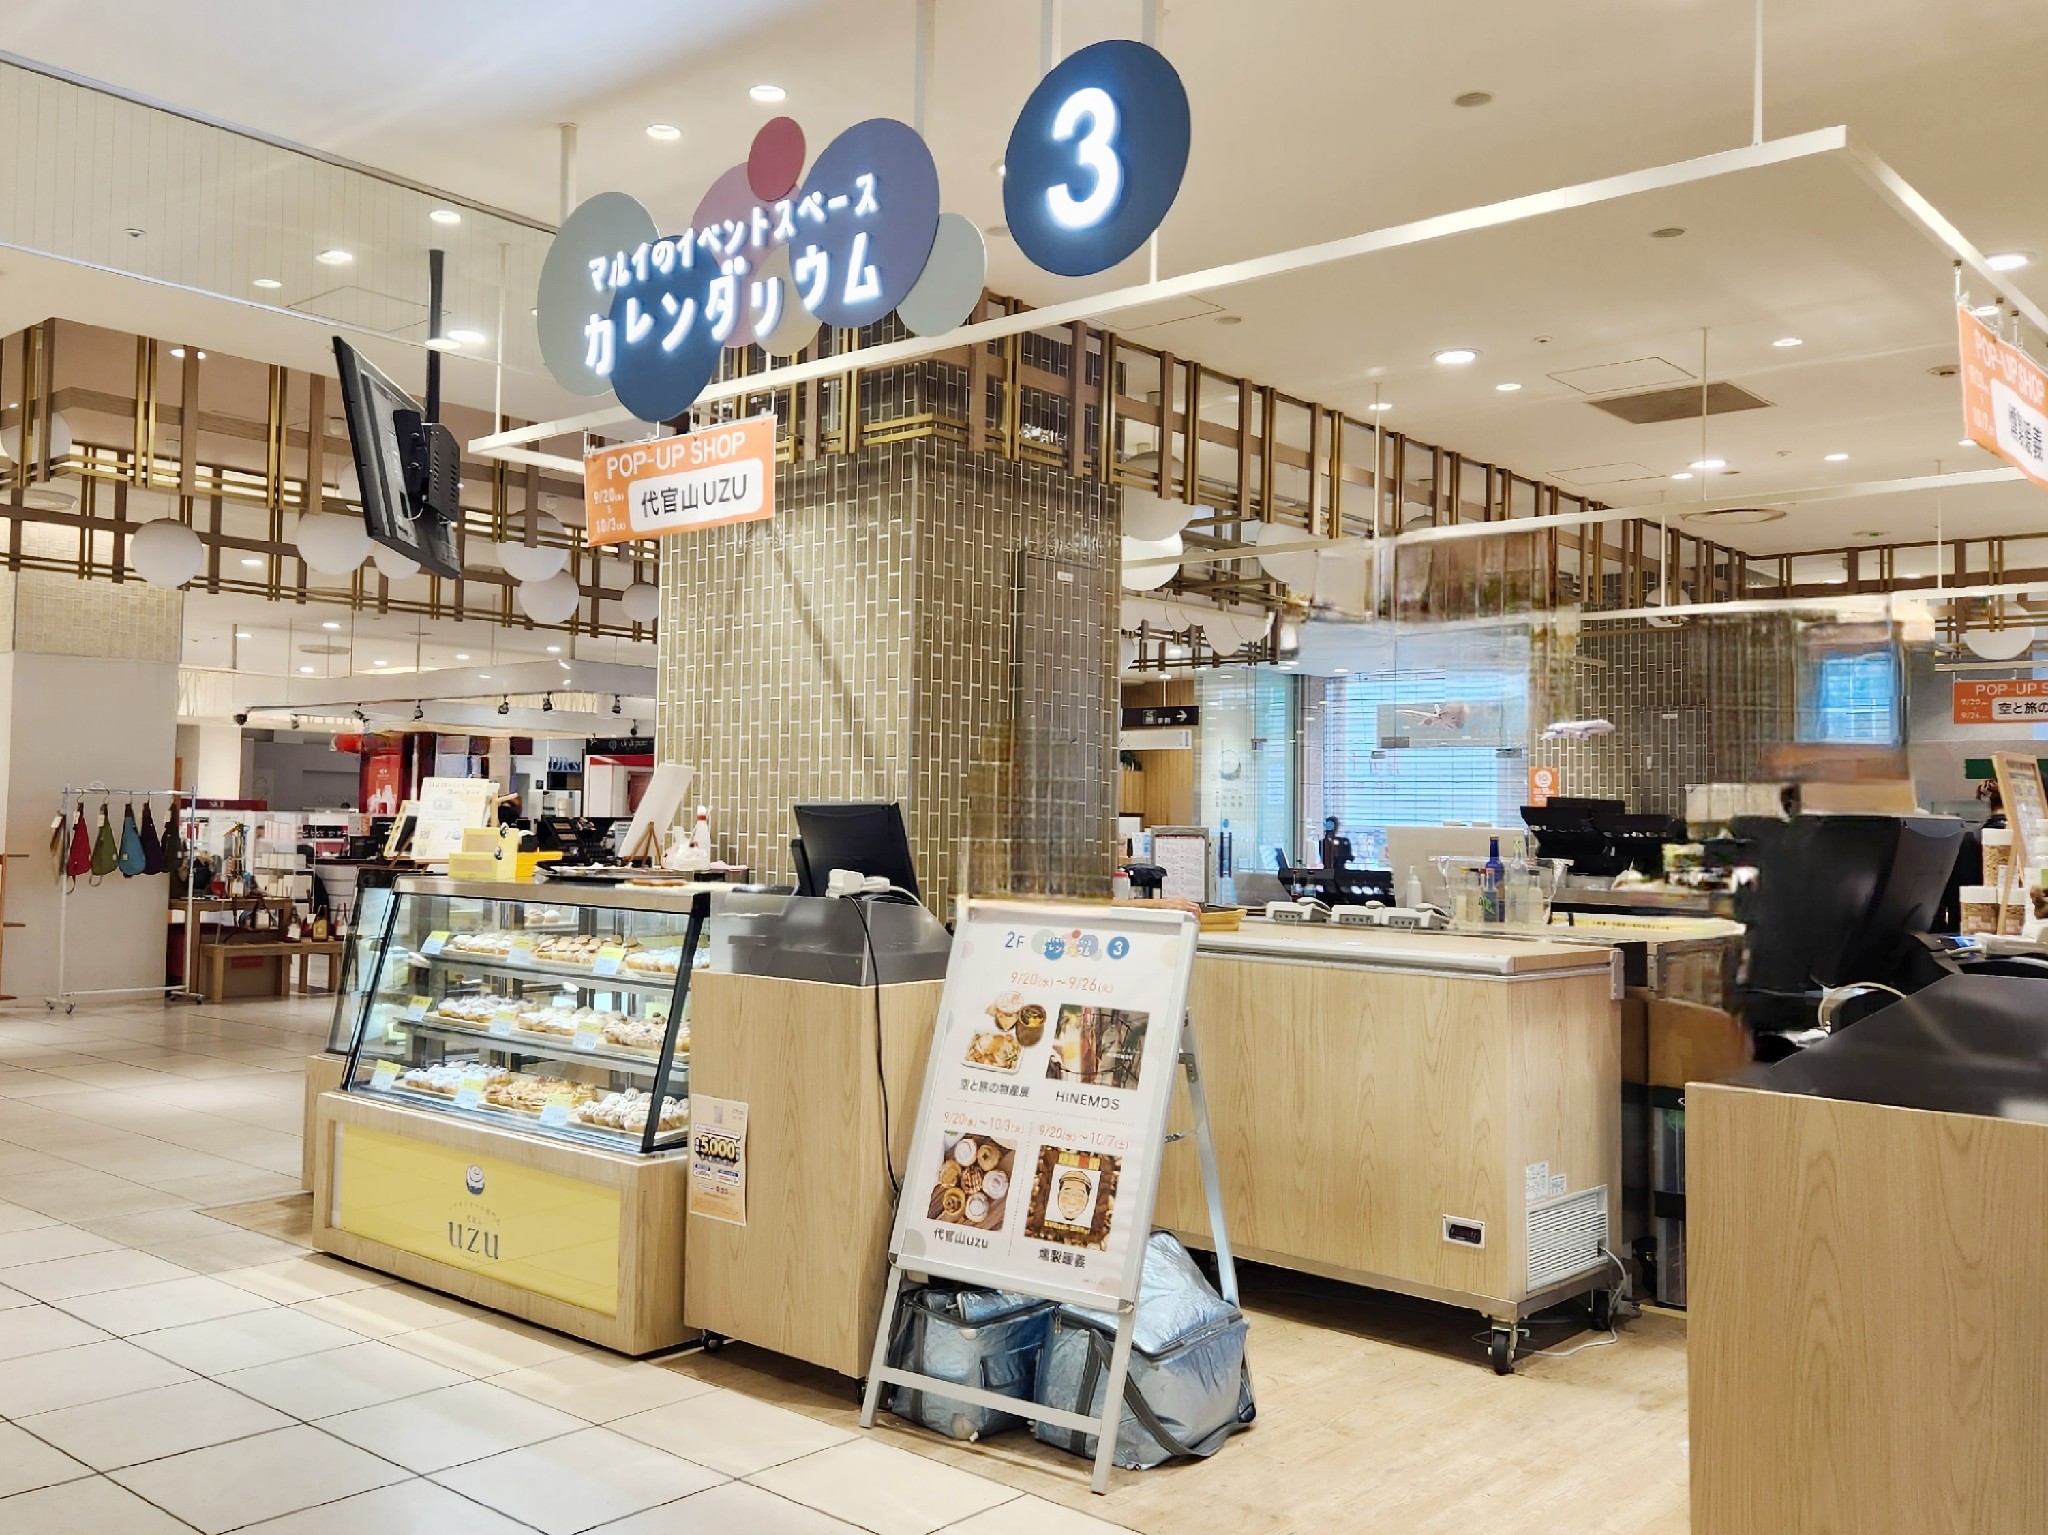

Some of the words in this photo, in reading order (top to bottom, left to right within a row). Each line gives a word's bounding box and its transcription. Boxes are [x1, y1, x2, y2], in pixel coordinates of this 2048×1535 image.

[1045, 86, 1122, 228] 3
[588, 173, 880, 293] マルイのイベントスペース
[584, 231, 884, 376] カレンダリウム
[606, 444, 685, 480] POP-UP
[690, 431, 746, 465] SHOP
[641, 473, 748, 518] 代官山UZU
[1976, 683, 2037, 695] POP-UP
[1005, 931, 1025, 949] 2F
[1112, 940, 1124, 956] 3
[1056, 1090, 1121, 1111] HINEMOS
